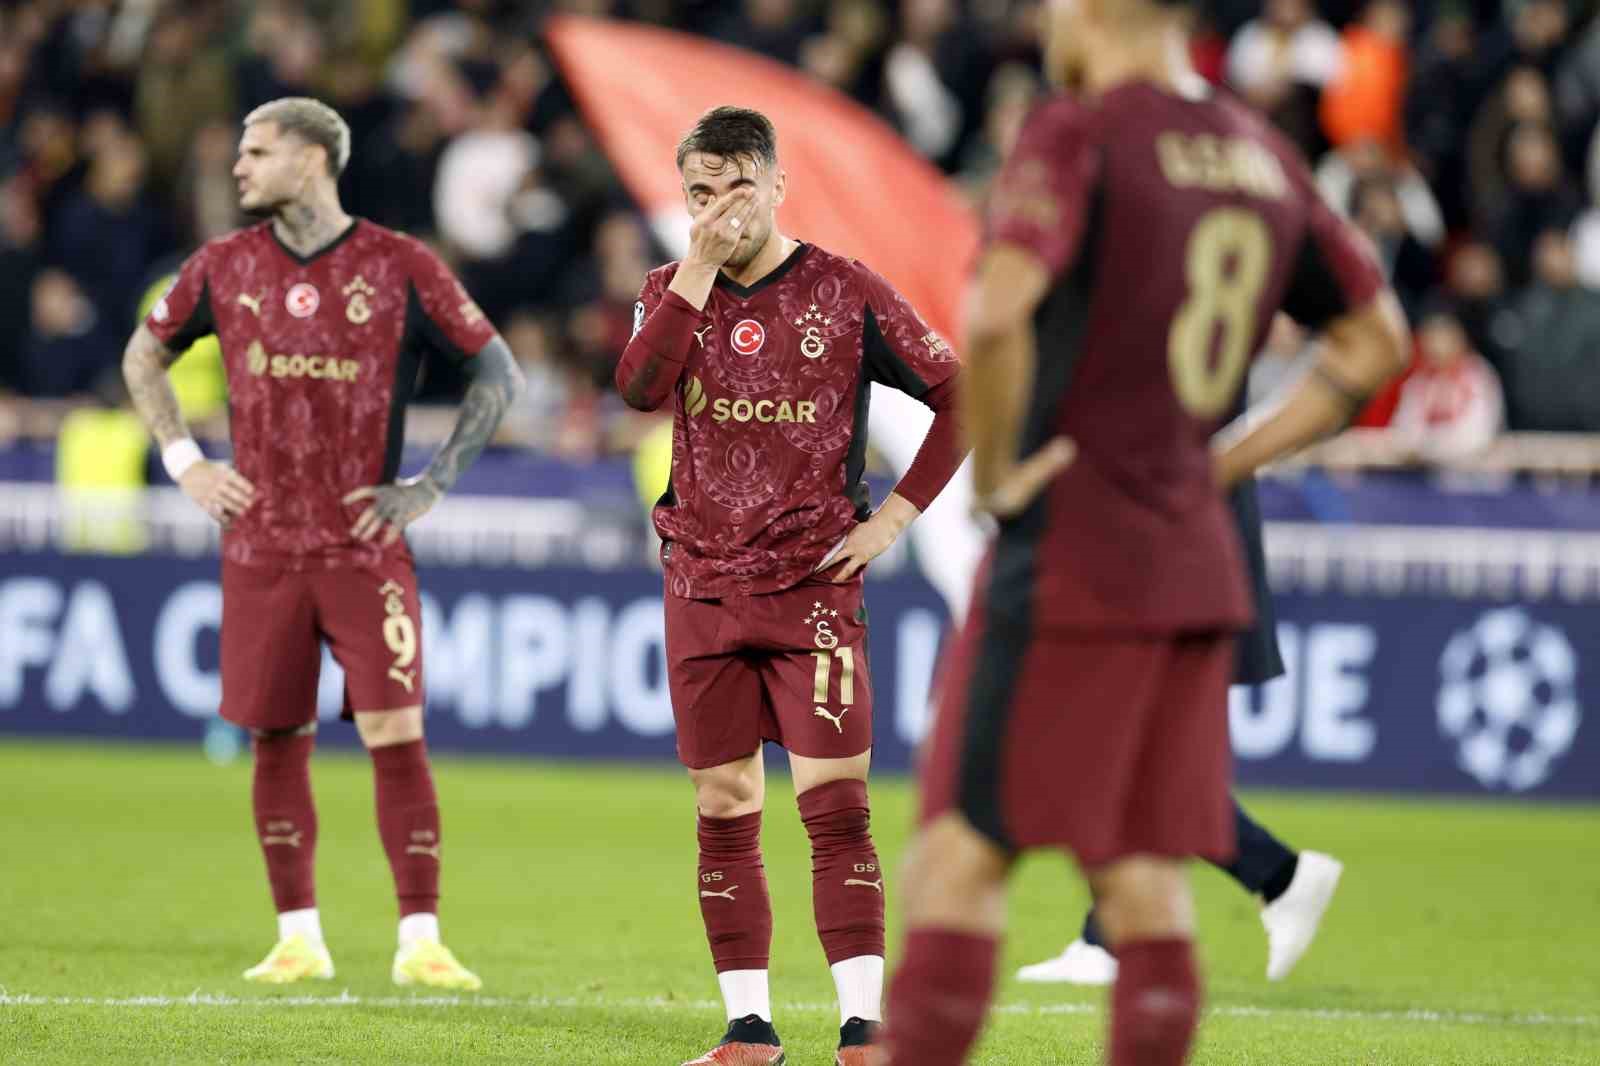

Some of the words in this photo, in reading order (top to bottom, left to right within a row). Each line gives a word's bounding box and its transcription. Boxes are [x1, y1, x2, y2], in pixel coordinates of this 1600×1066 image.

[1167, 206, 1272, 419] 8
[271, 355, 360, 382] SOCAR
[712, 398, 816, 424] SOCAR
[382, 614, 416, 668] 9
[811, 647, 854, 704] 11
[701, 871, 723, 883] GS
[854, 863, 876, 872] GS
